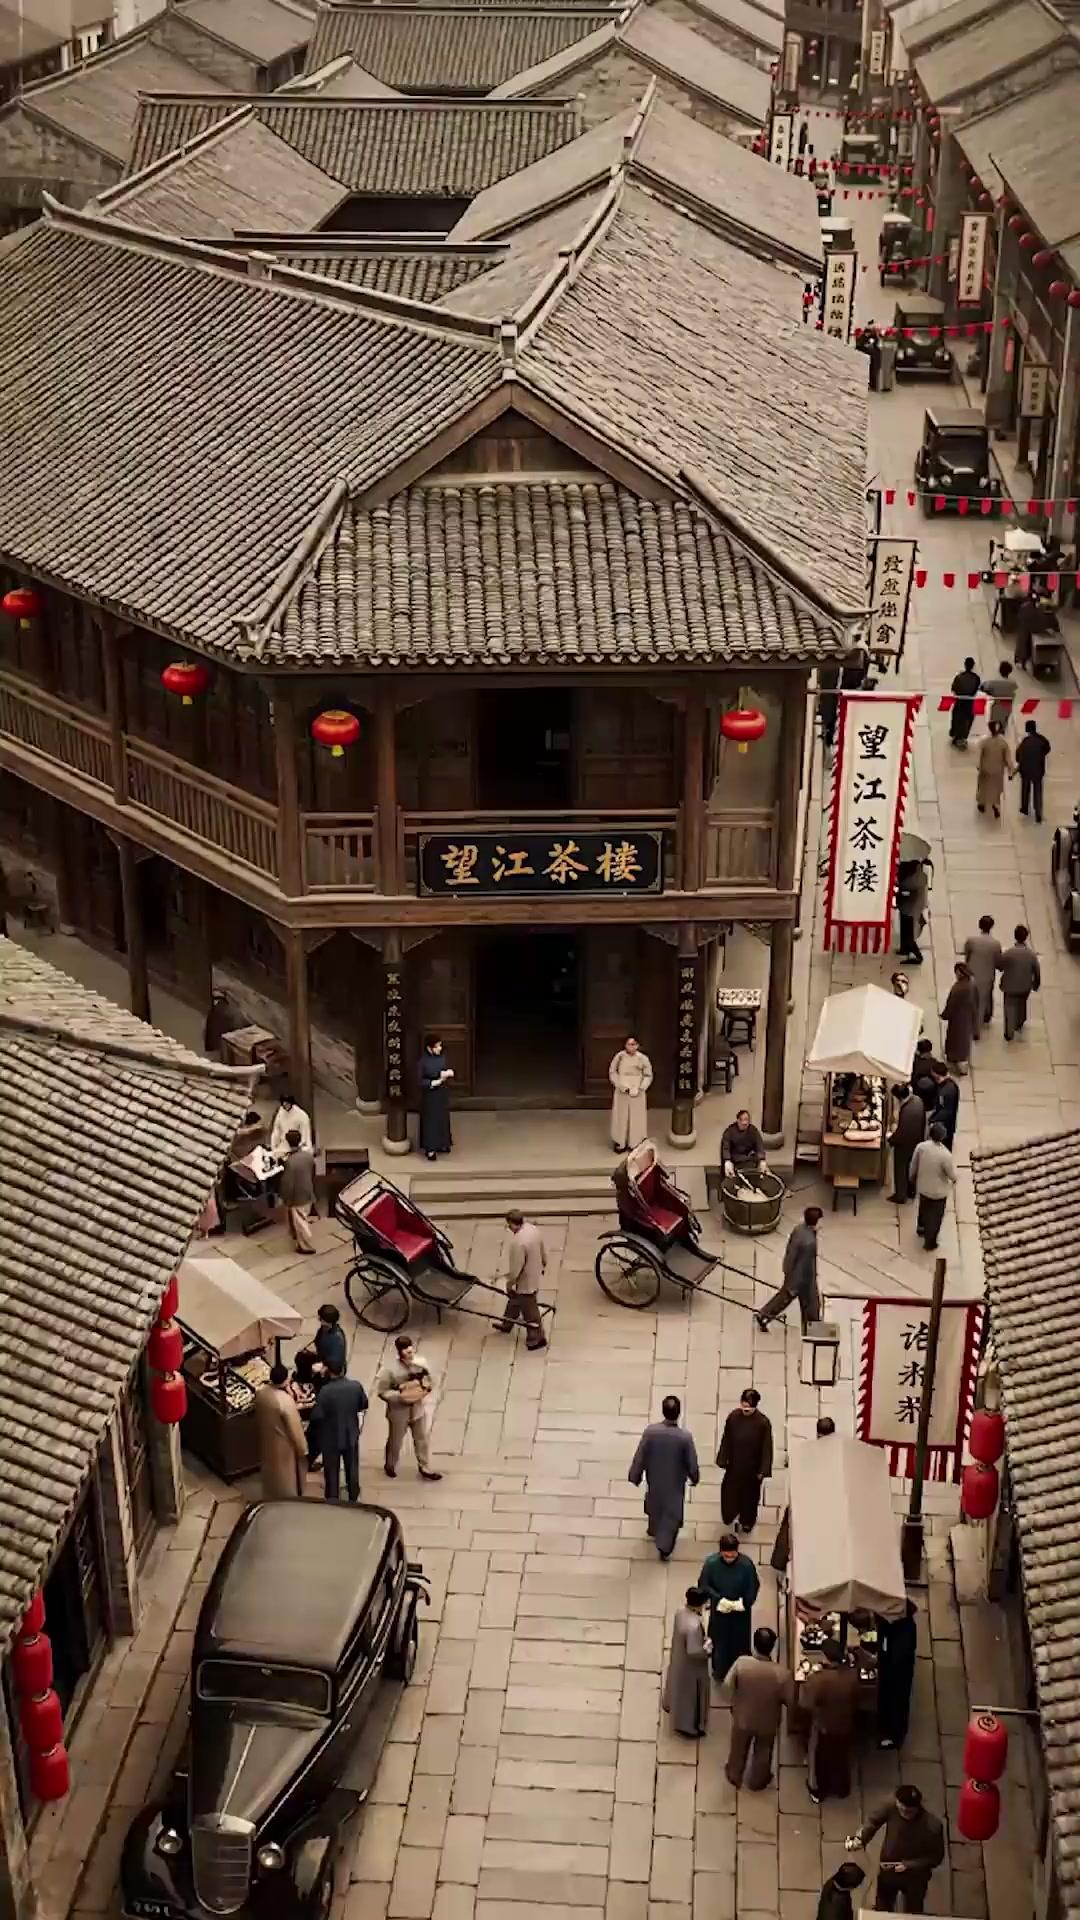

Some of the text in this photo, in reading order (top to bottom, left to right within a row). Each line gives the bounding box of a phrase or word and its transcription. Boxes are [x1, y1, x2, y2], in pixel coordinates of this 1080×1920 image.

[844, 724, 889, 893] 望江茶楼
[439, 840, 643, 884] 望江茶楼
